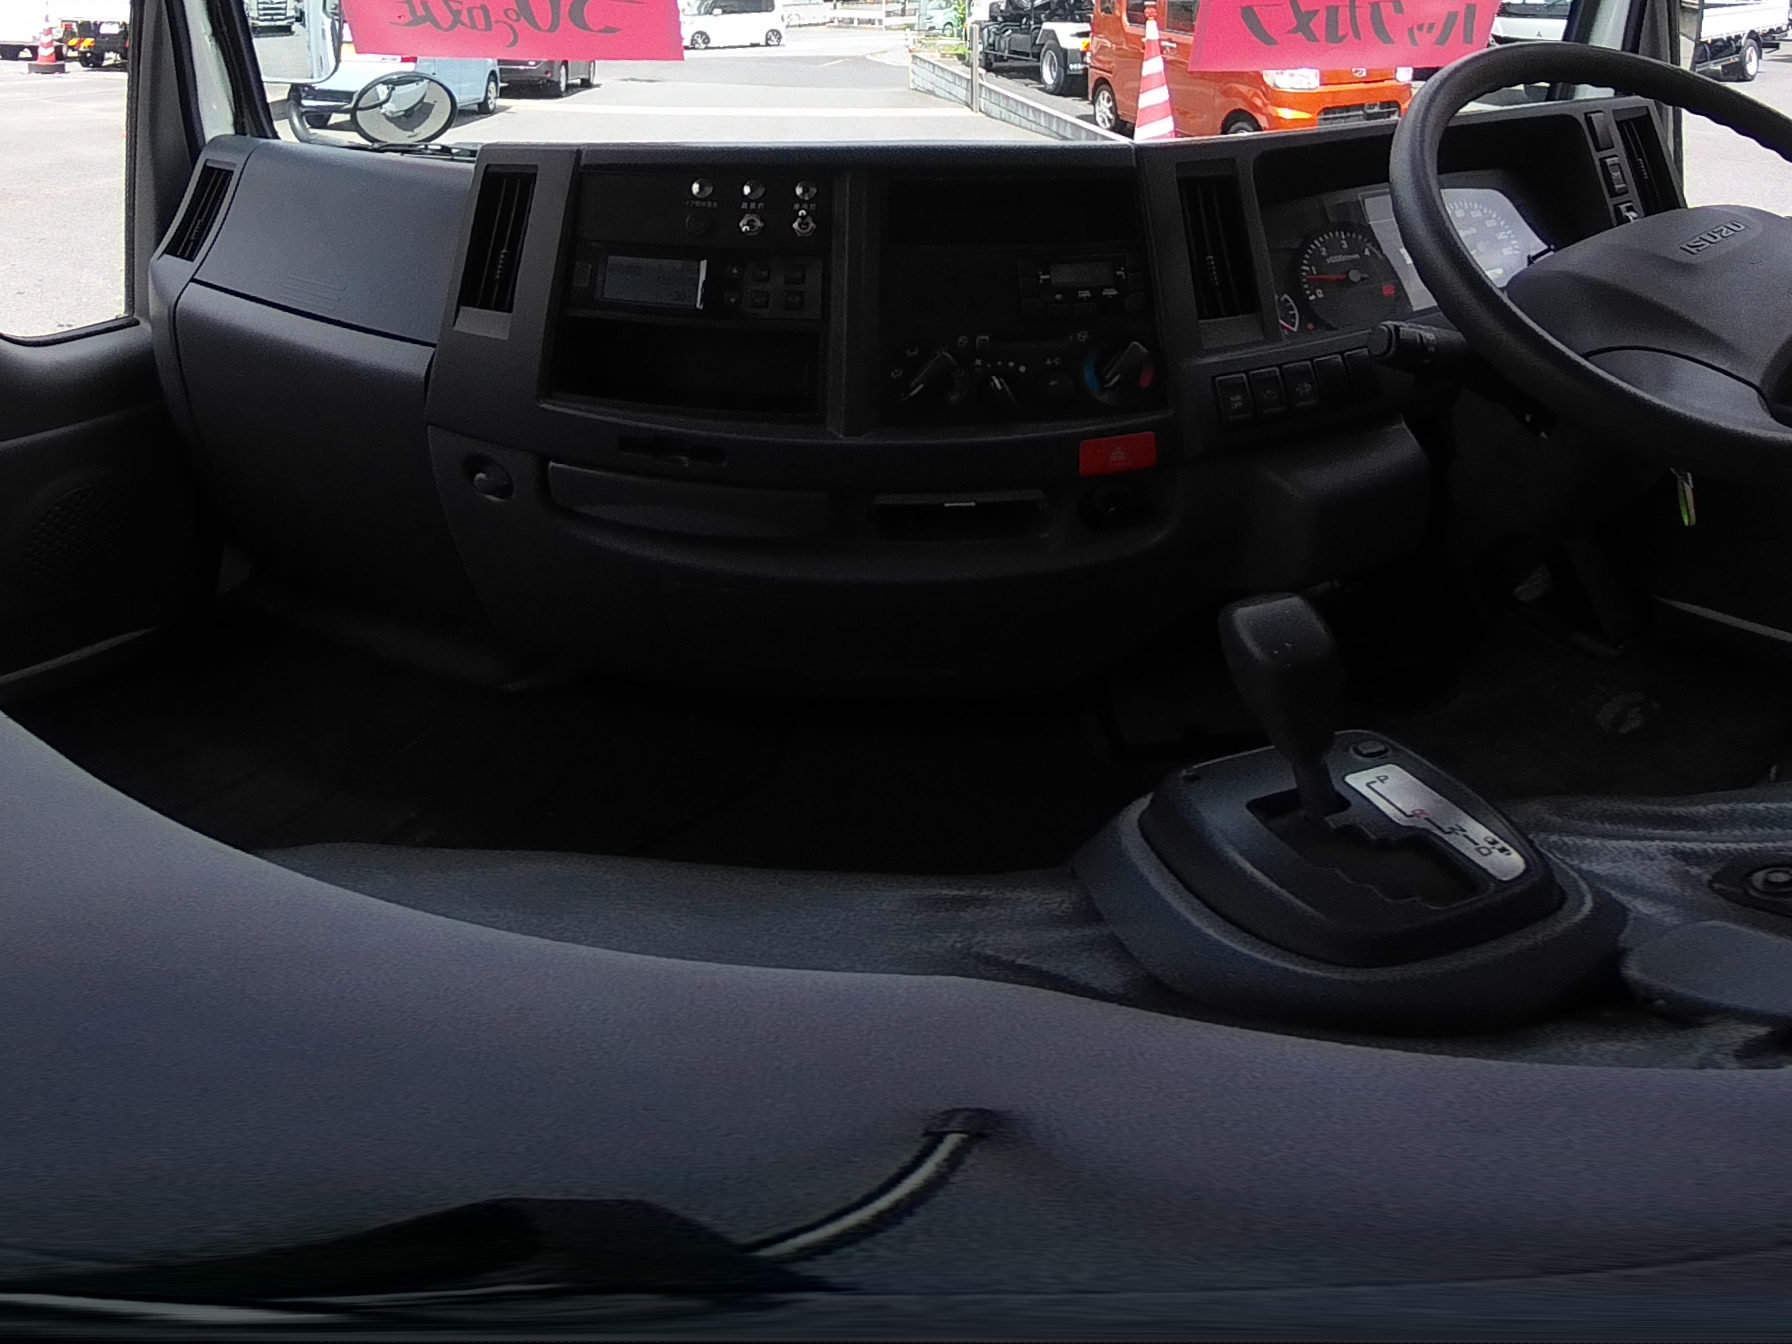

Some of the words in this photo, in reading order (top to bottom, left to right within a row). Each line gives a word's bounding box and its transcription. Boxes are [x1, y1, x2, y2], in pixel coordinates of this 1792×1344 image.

[1679, 220, 1747, 255] ISUZU
[1340, 239, 1348, 249] 3
[1319, 246, 1328, 256] 2
[1375, 774, 1390, 784] P
[1475, 846, 1494, 858] D
